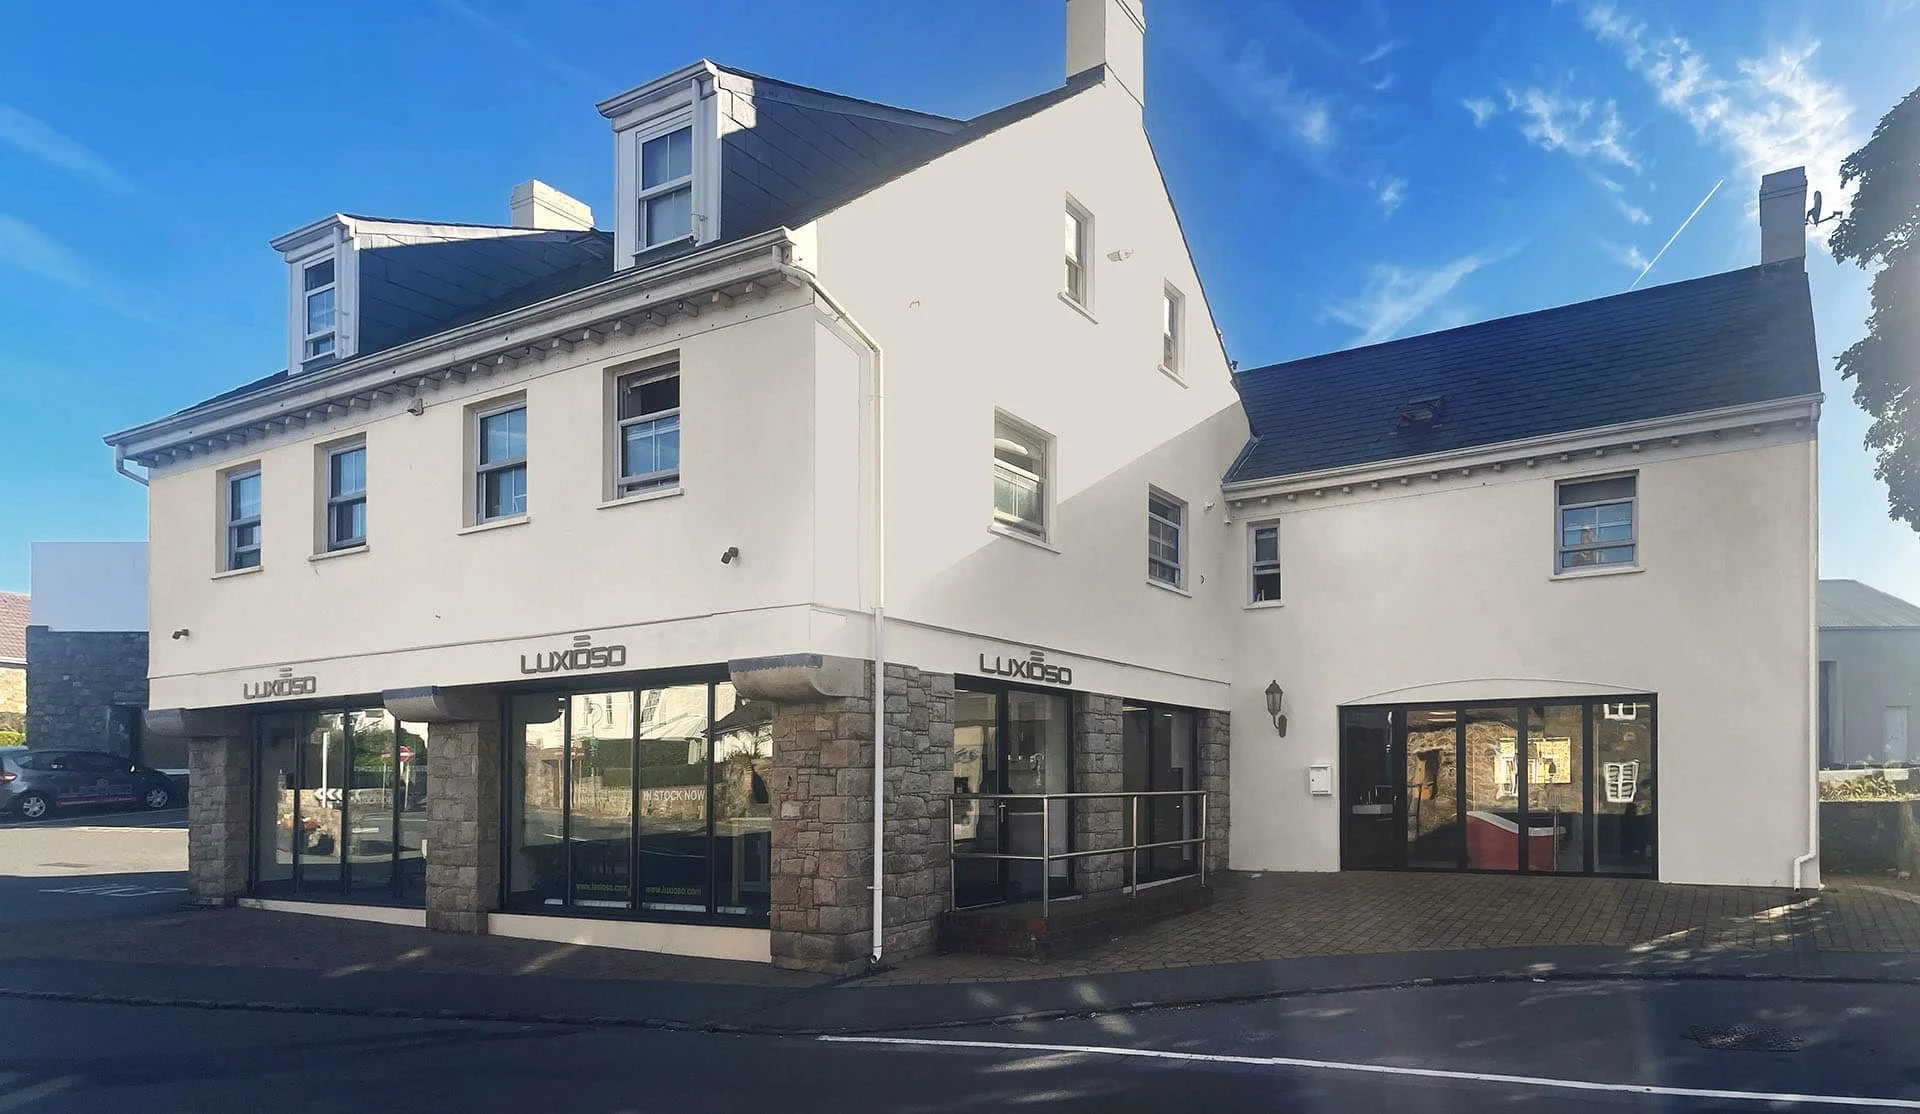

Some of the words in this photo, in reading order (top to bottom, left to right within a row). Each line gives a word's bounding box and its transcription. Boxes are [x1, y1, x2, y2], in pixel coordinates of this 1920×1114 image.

[520, 635, 626, 674] LUXIOSO
[979, 651, 1073, 685] LUXIOSO
[243, 668, 317, 700] LUXIOSO
[643, 789, 652, 801] IN
[653, 789, 683, 801] STOCK
[683, 788, 706, 801] NOW
